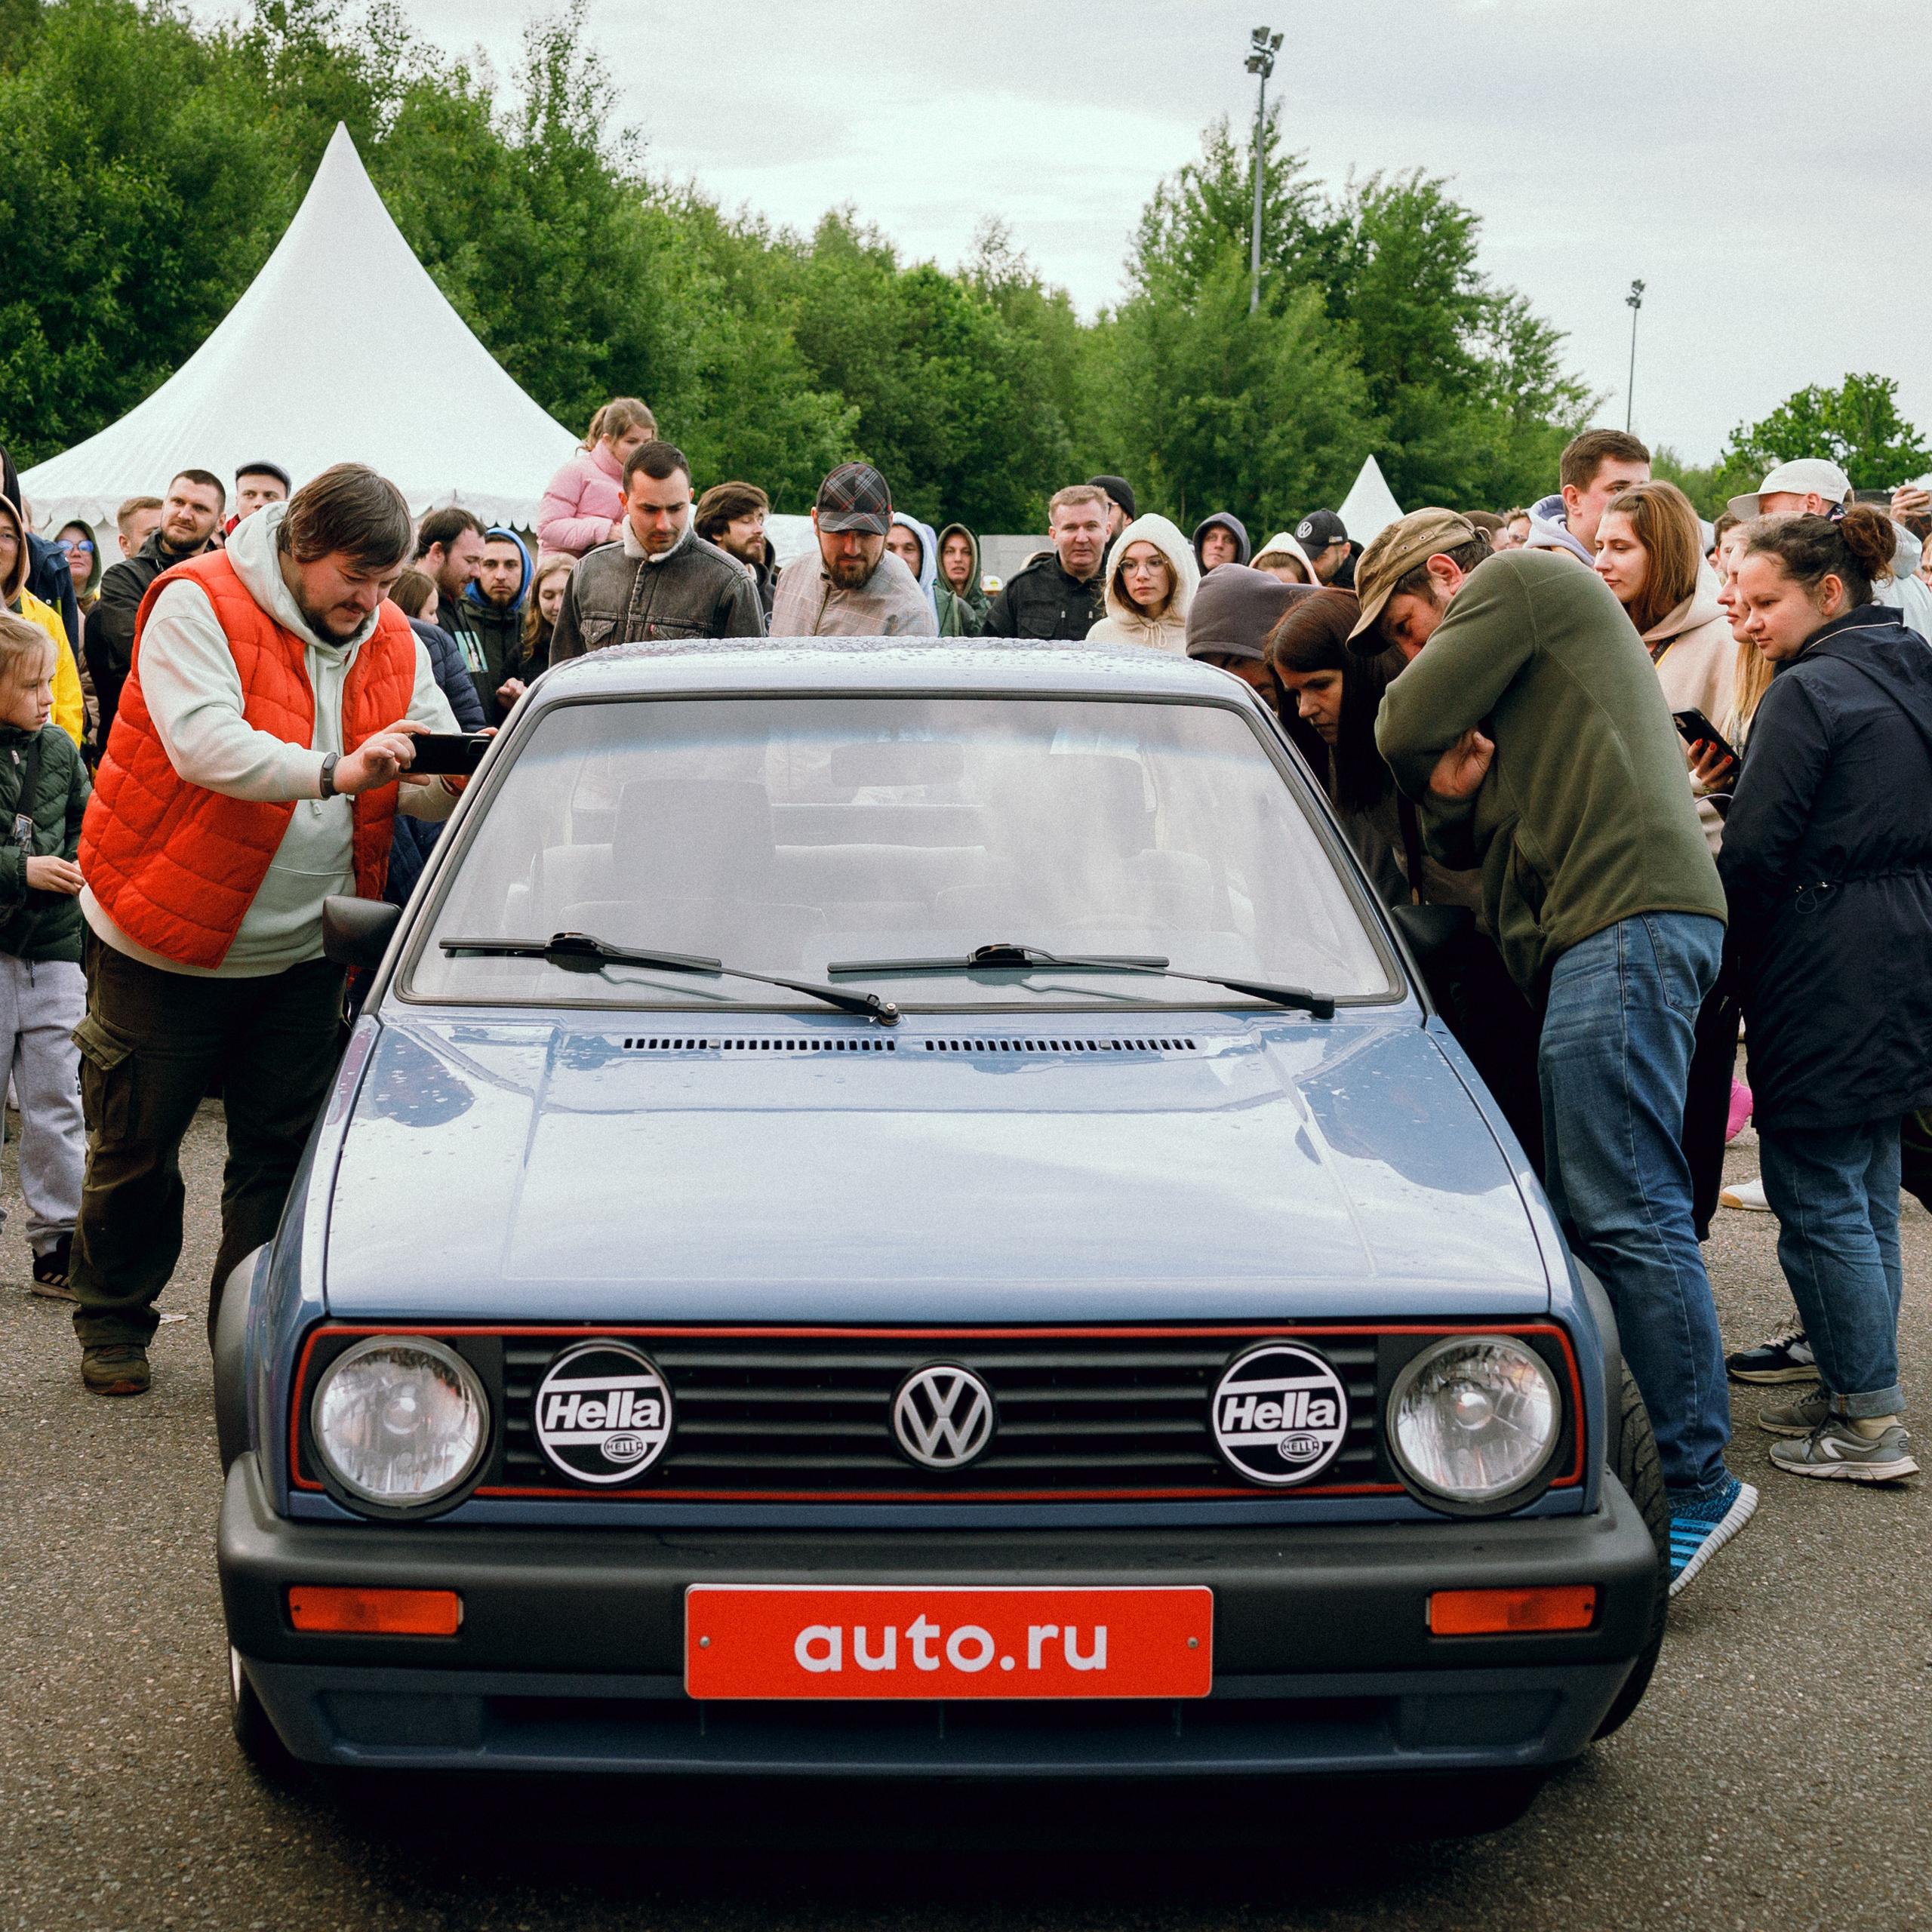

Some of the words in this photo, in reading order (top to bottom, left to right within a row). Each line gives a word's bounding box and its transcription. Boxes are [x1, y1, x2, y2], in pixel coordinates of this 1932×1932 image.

[544, 1391, 660, 1429] Hella
[898, 1369, 989, 1463] VW
[1222, 1392, 1337, 1431] Hella
[607, 1440, 643, 1454] HELLA
[1284, 1439, 1319, 1453] HELLA
[794, 1614, 1107, 1672] auto.ru
